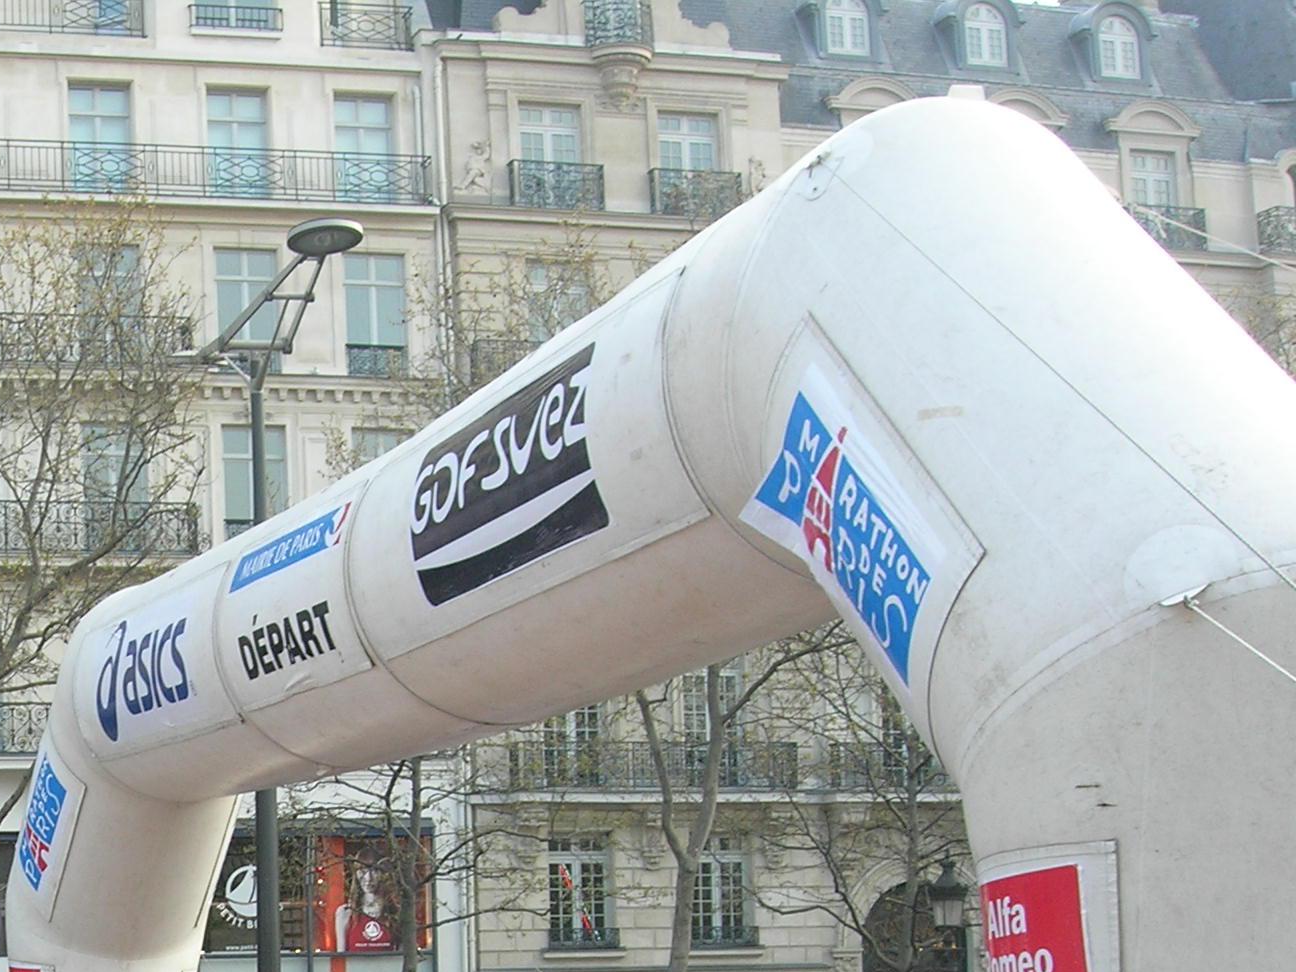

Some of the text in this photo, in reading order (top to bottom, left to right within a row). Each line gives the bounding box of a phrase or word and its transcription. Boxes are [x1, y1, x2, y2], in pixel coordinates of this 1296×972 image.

[411, 430, 490, 535] GDF
[274, 539, 291, 564] DE
[289, 522, 324, 557] PARIS
[858, 543, 887, 596] DE
[238, 600, 336, 680] DÉPART
[988, 896, 1027, 940] Alfa
